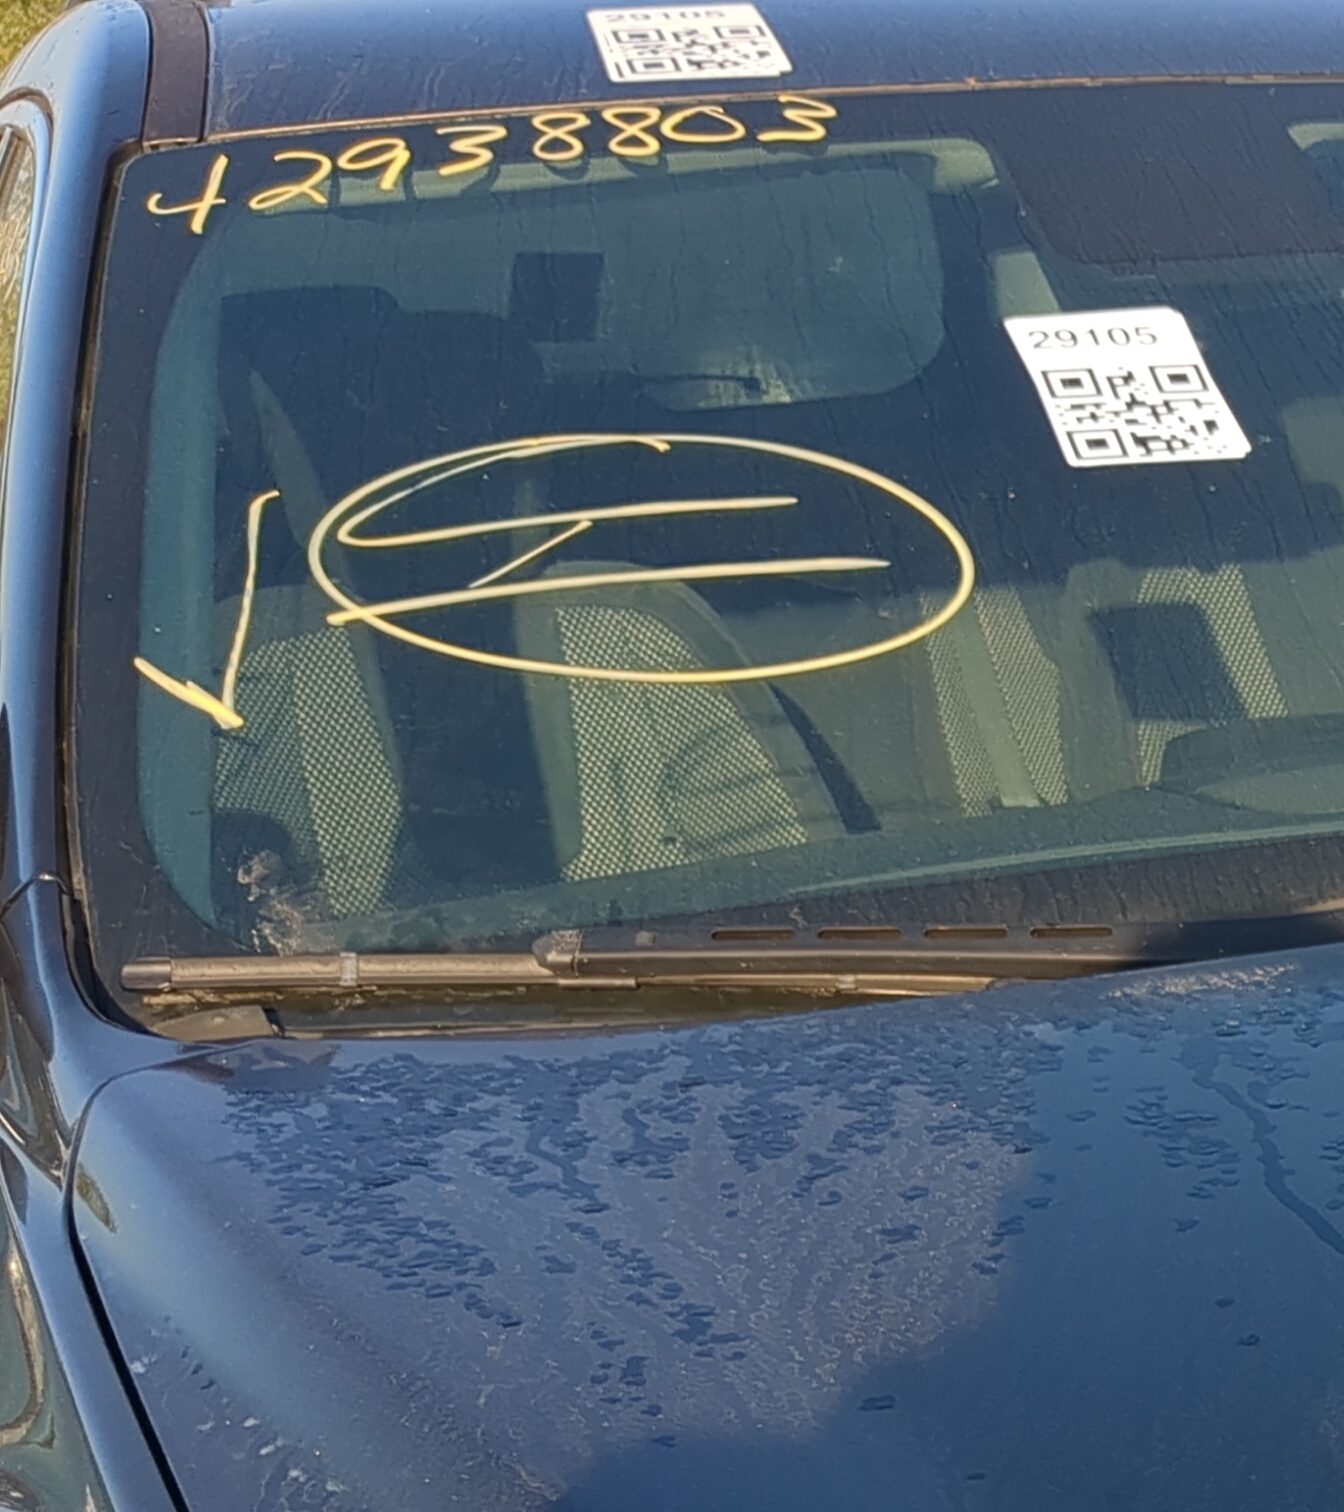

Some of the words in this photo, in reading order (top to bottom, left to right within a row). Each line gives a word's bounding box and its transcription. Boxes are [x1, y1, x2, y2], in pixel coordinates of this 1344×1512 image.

[605, 10, 726, 23] 29105
[146, 95, 837, 235] 42938803
[1027, 326, 1158, 349] 29105
